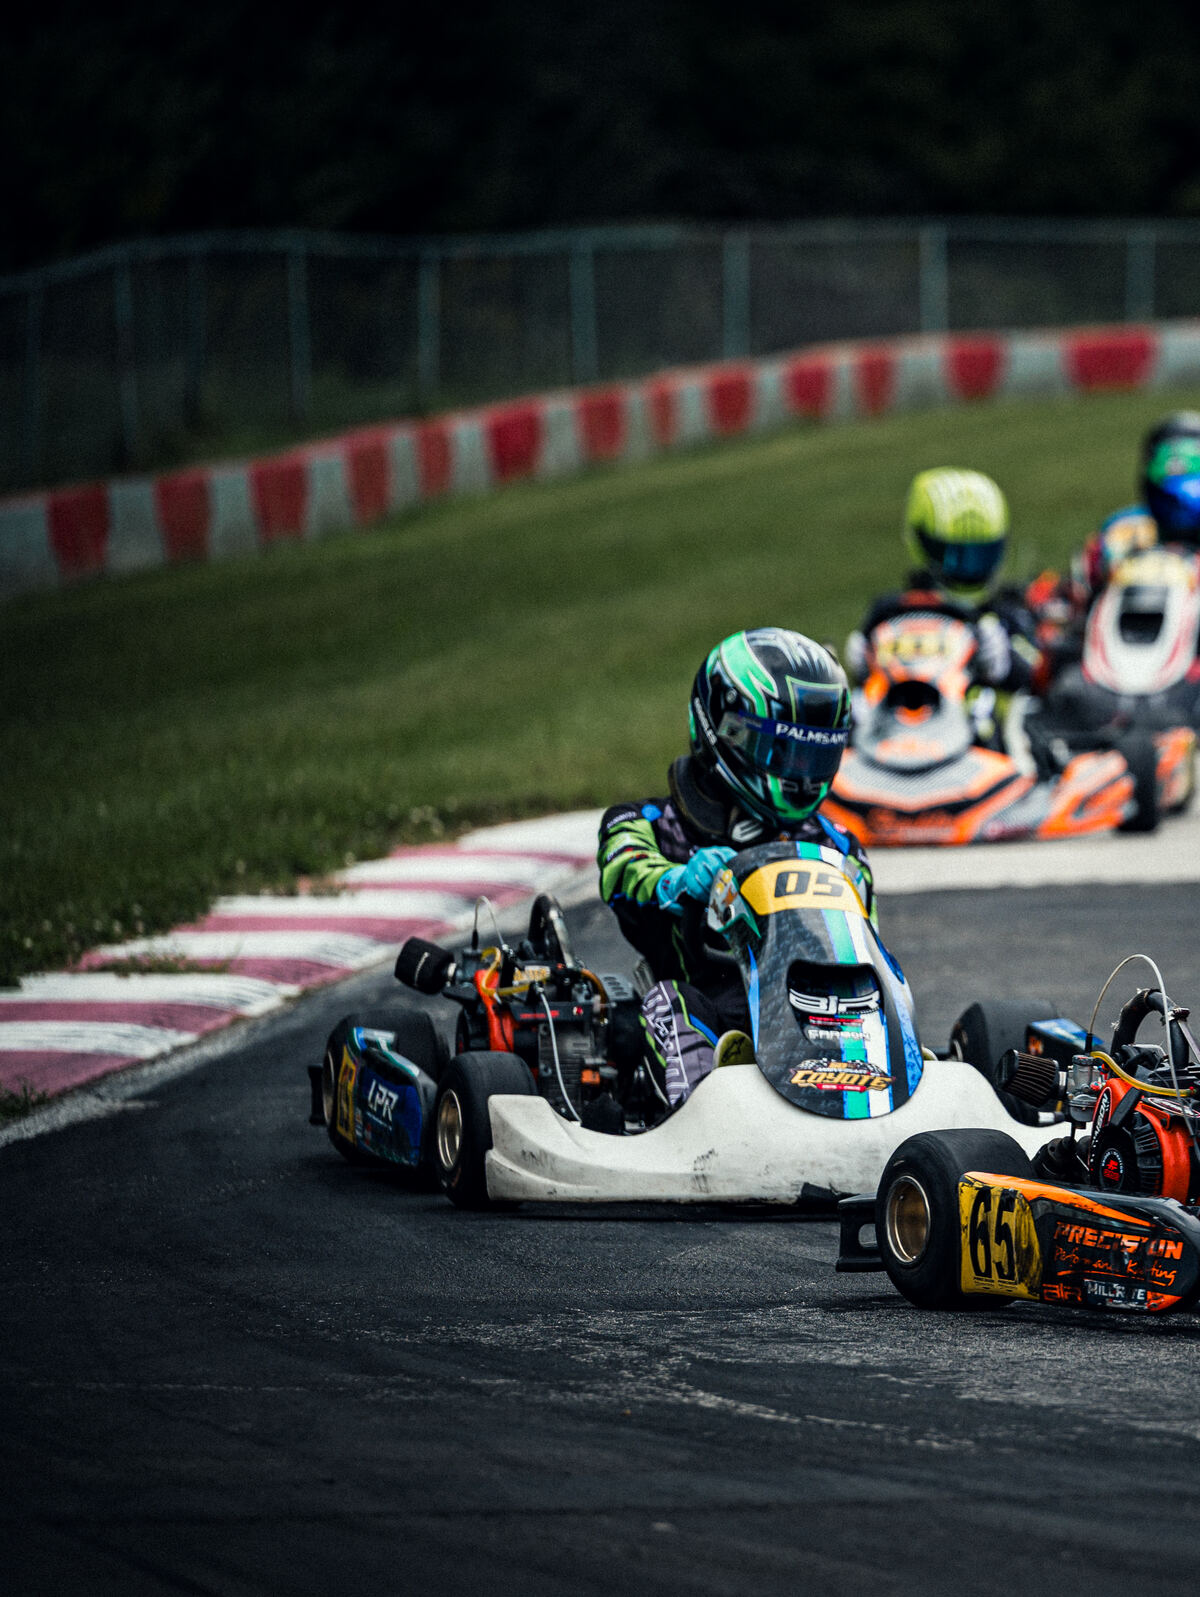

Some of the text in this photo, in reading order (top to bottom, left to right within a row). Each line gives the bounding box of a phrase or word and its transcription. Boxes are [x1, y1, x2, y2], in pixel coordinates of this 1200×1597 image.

[774, 870, 845, 898] 05
[791, 1070, 892, 1089] COYOTE
[969, 1186, 1018, 1281] 65
[1087, 1281, 1147, 1301] MILLRTE
